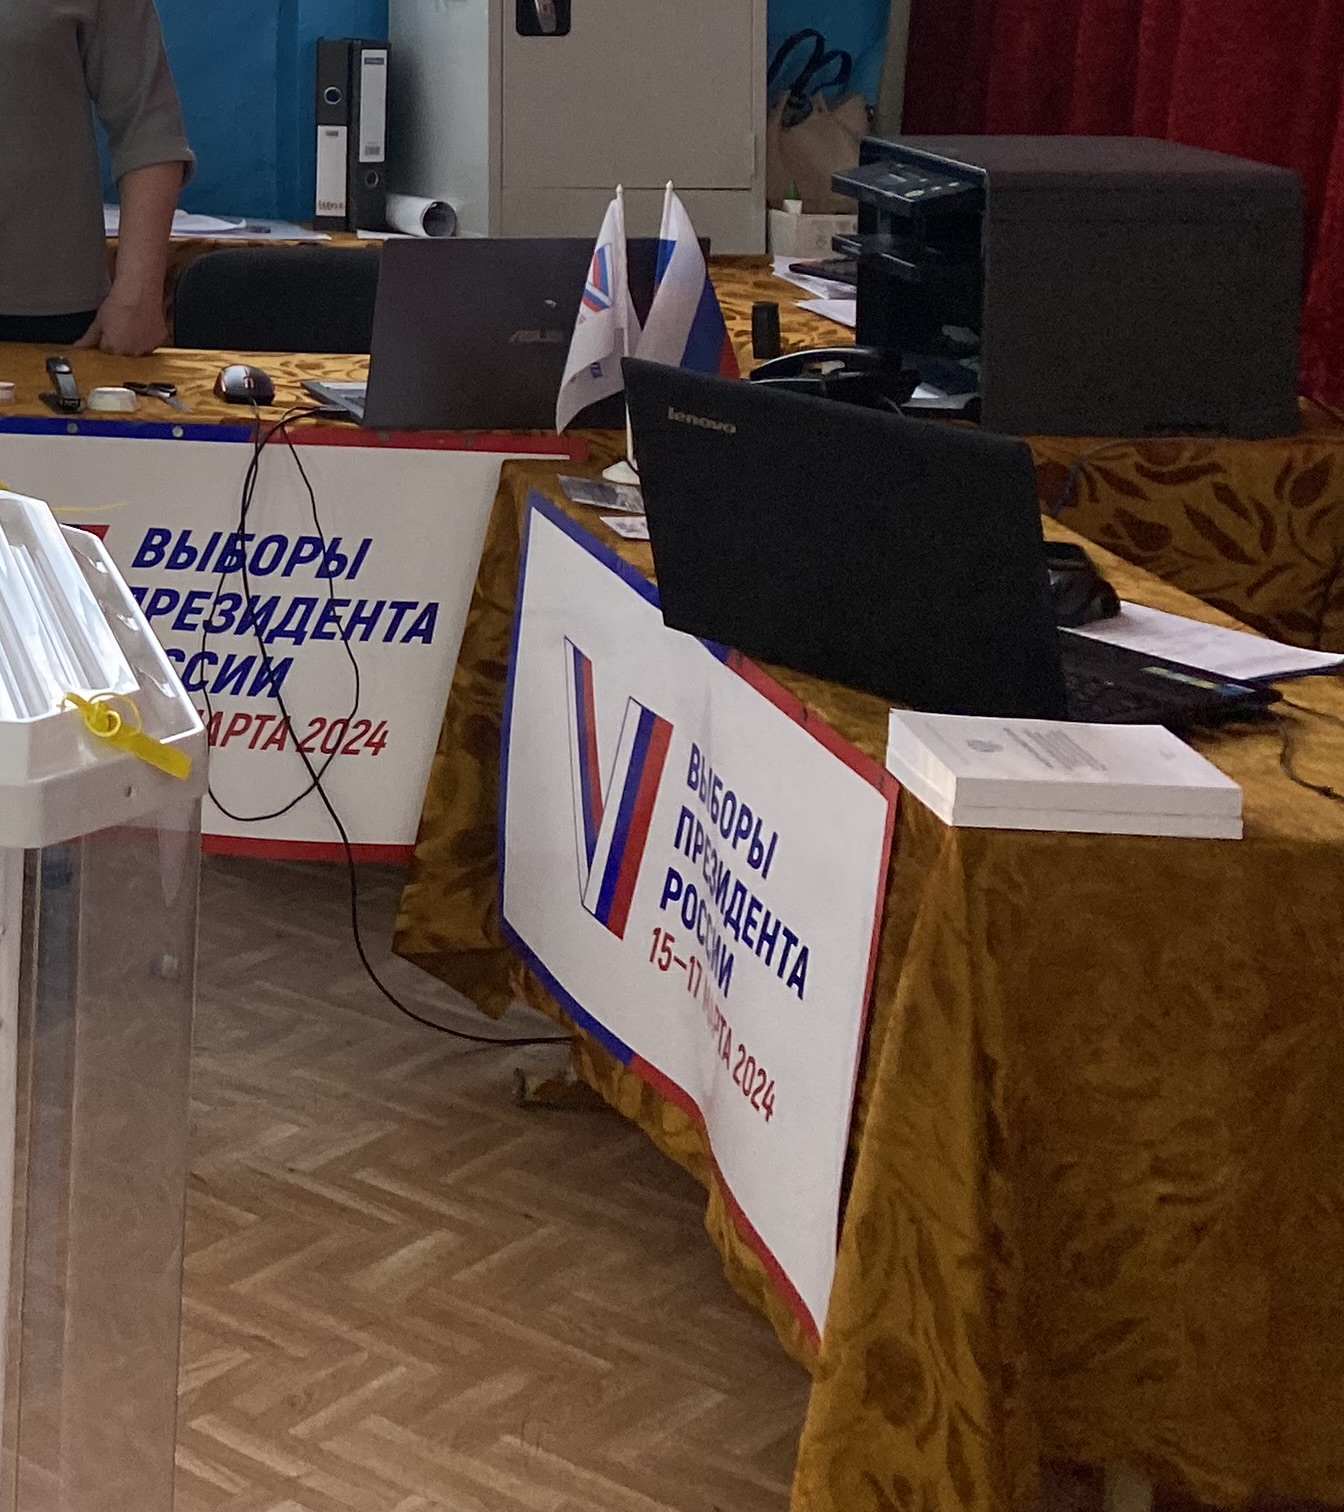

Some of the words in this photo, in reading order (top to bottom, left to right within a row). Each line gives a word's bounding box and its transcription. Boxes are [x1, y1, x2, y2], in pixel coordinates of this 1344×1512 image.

[132, 527, 373, 581] ВЫБОРЫ
[195, 709, 292, 752] АРТА
[297, 716, 389, 757] 2024
[686, 742, 779, 879] ВЫБОРЫ
[659, 867, 735, 998] РОССИИ
[674, 805, 810, 1000] ПРЕЗИДЕНТА
[732, 1043, 776, 1123] 2024
